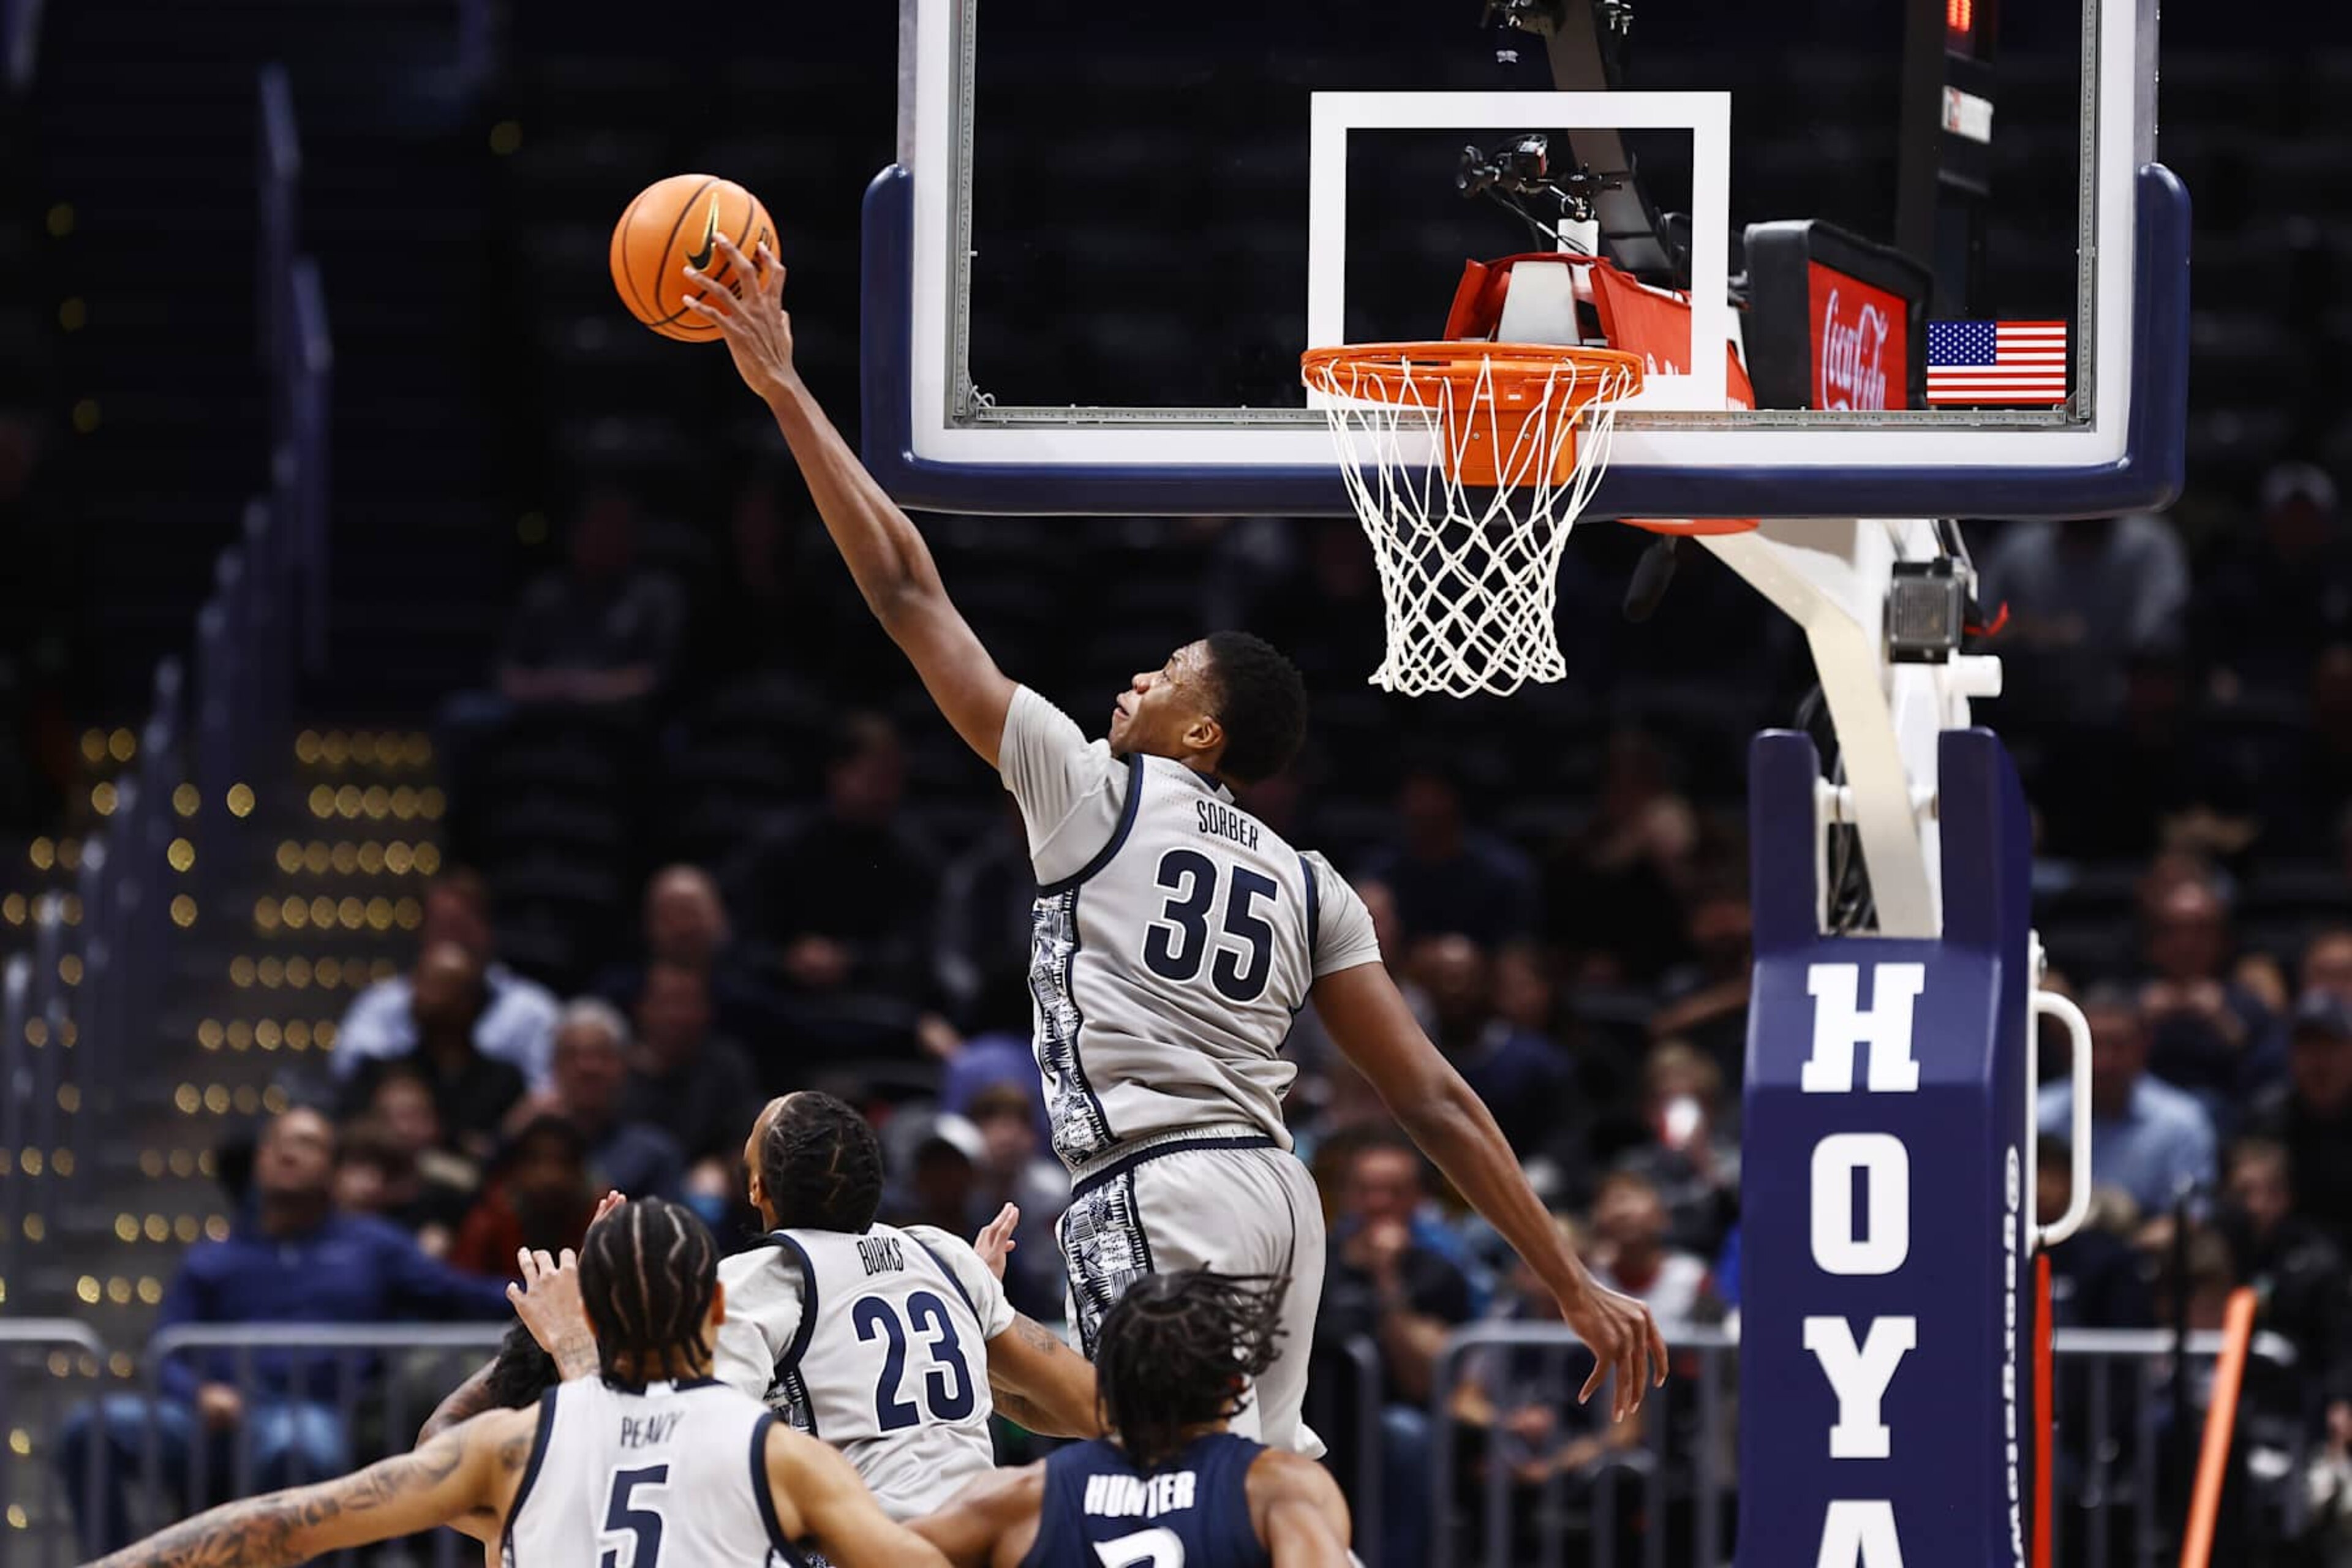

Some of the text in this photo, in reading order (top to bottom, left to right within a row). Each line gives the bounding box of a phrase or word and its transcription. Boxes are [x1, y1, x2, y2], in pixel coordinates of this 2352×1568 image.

[1196, 799, 1259, 851] SORBER
[1141, 846, 1278, 1005] 35
[857, 1237, 905, 1276] BURKS
[851, 1289, 976, 1433] 23
[2003, 1144, 2024, 1568] @georgetow
[620, 1410, 685, 1449] PEAVY
[597, 1461, 671, 1568] 5
[1084, 1470, 1197, 1520] HUNTER
